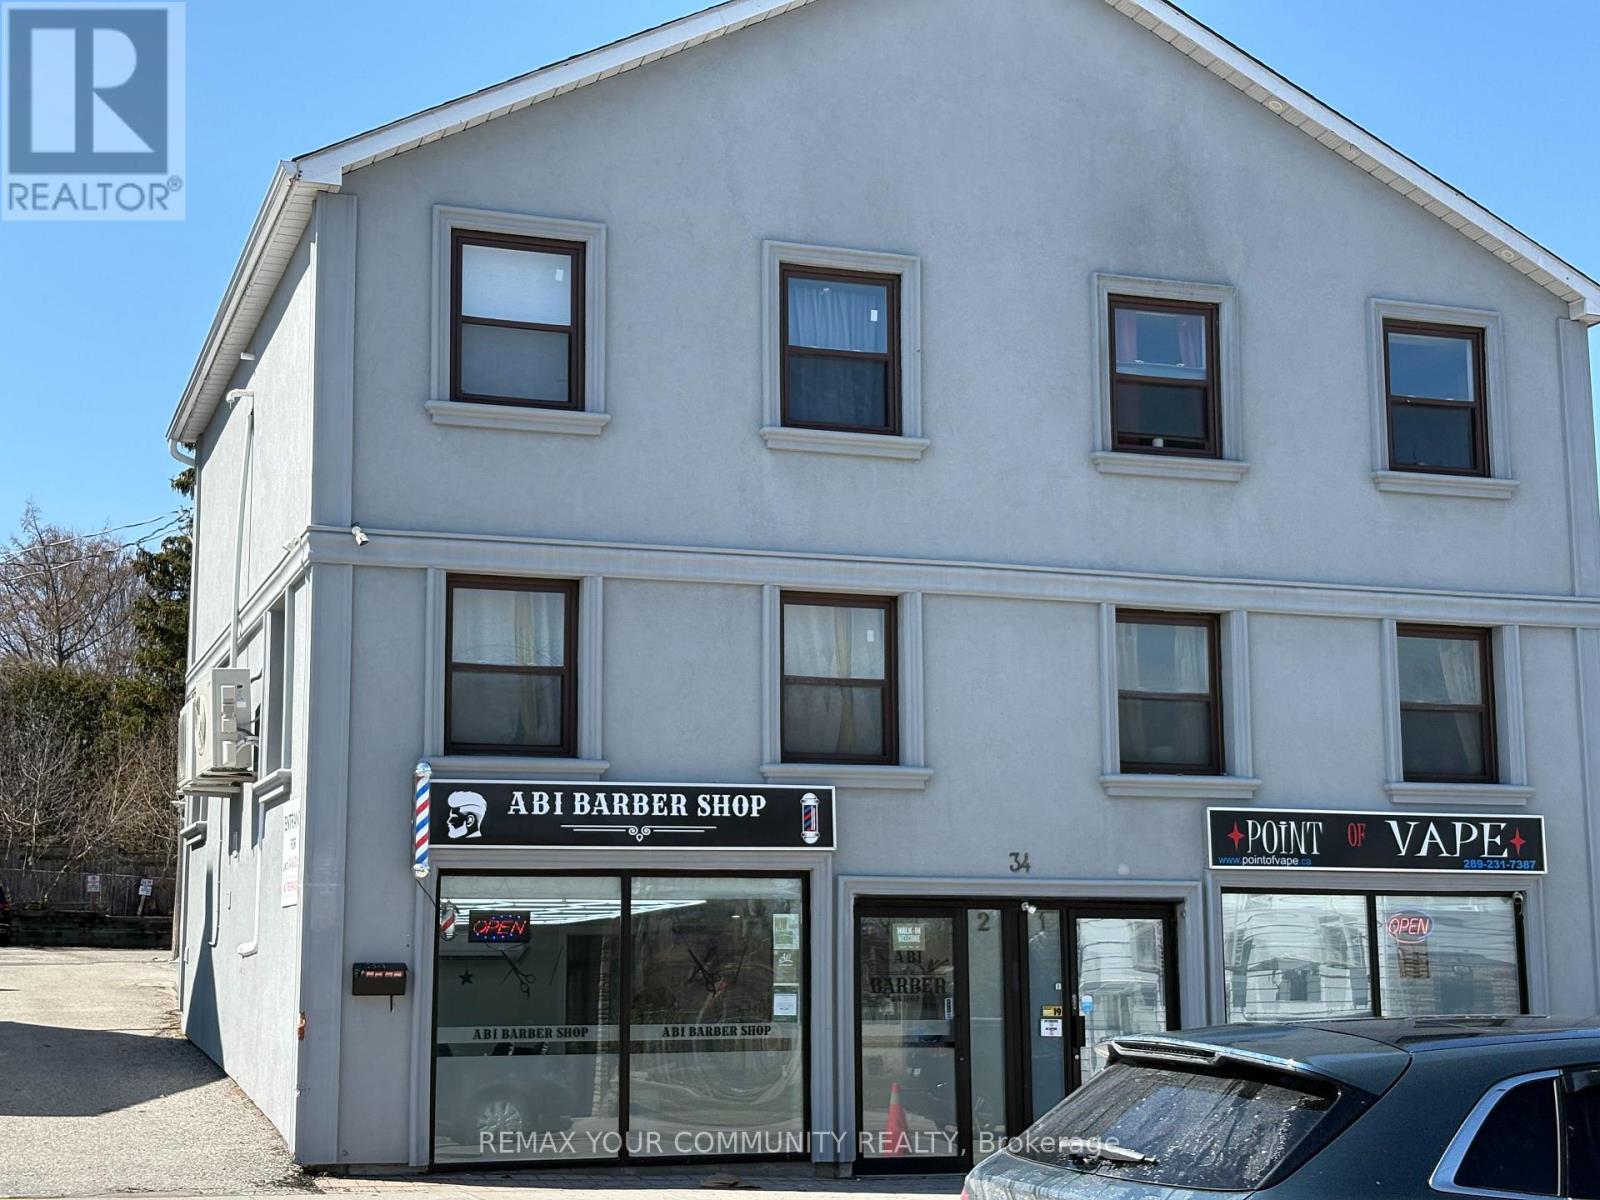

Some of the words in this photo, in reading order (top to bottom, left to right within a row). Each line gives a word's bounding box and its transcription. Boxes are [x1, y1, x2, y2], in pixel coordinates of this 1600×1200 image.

[507, 791, 563, 815] ABI
[573, 792, 688, 817] BARBER
[697, 794, 767, 817] SHOP
[1347, 822, 1366, 847] OF
[1385, 820, 1508, 858] VAPE
[1009, 852, 1031, 872] 34
[1218, 854, 1312, 867] www.pointofvape.ca
[1463, 859, 1536, 870] 289-231-7387
[473, 920, 526, 934] OPEN
[977, 911, 990, 931] 2
[1388, 918, 1429, 935] OPEN
[870, 976, 947, 994] BARBER
[473, 1028, 497, 1040] ABI
[501, 1028, 552, 1039] BARBER
[556, 1027, 589, 1038] SHOP
[662, 1026, 685, 1037] ABI
[689, 1026, 737, 1037] BARBER
[741, 1025, 771, 1036] SHOP
